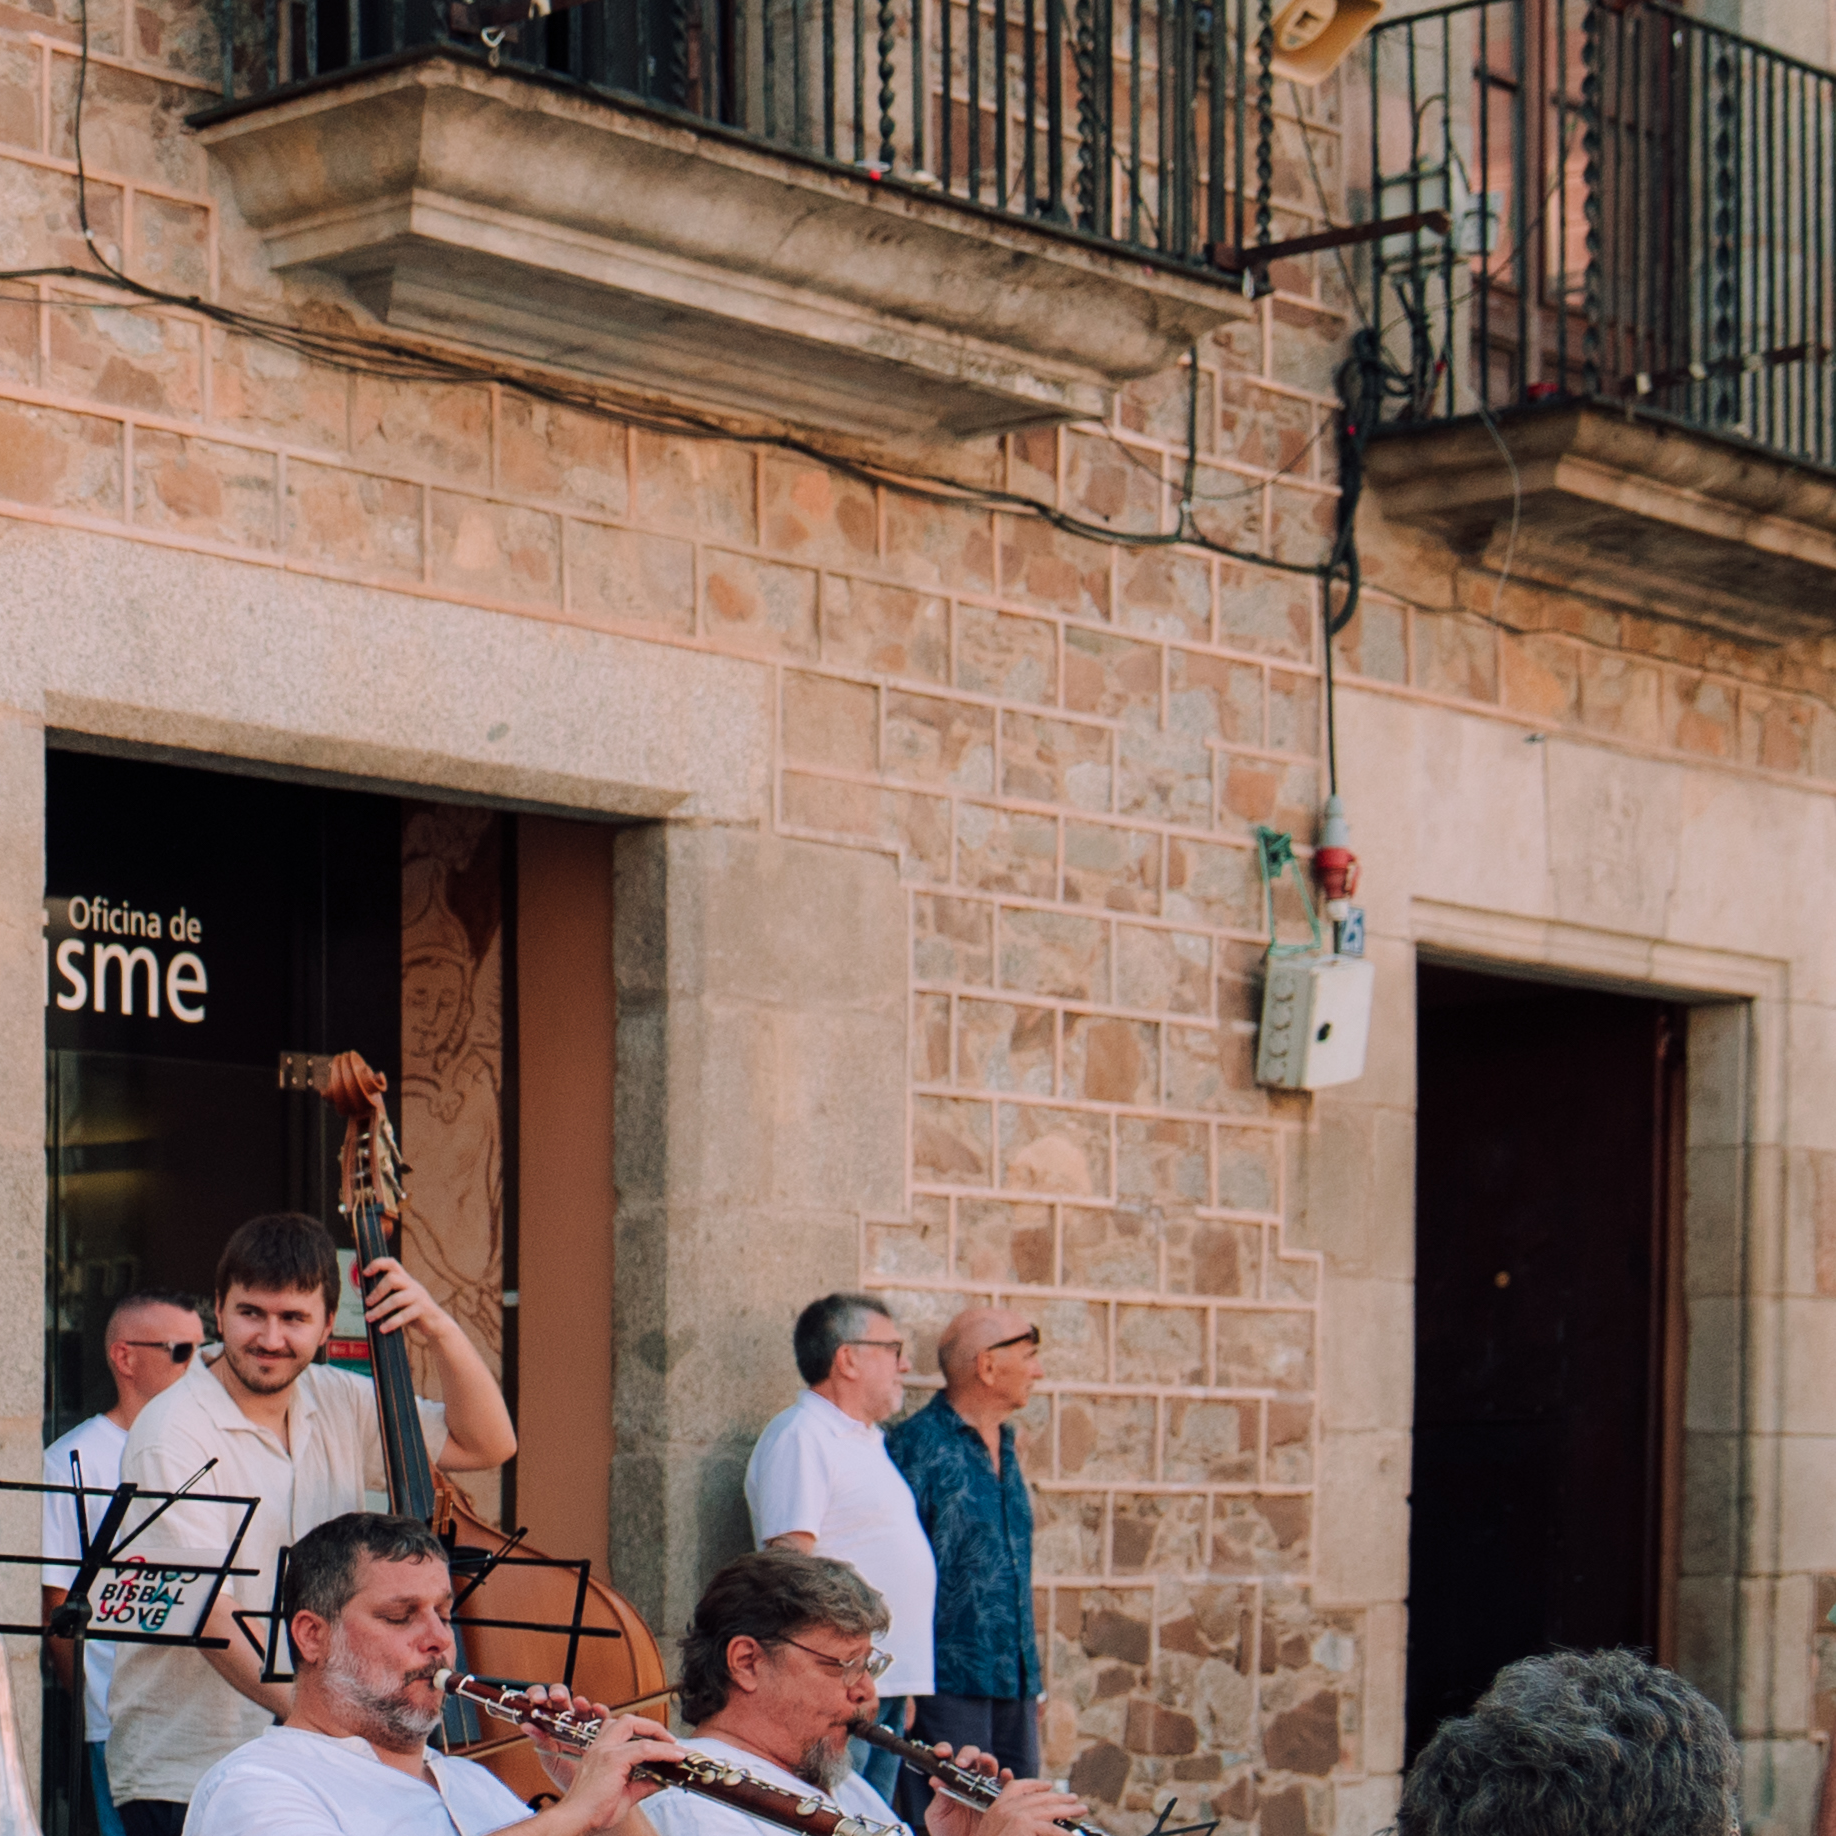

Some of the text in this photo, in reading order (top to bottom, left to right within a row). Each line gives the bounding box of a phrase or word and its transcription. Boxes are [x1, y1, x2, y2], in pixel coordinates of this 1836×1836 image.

[68, 895, 202, 944] Oficina de
[99, 1583, 185, 1605] BISBAL
[96, 1605, 169, 1626] JOVE
